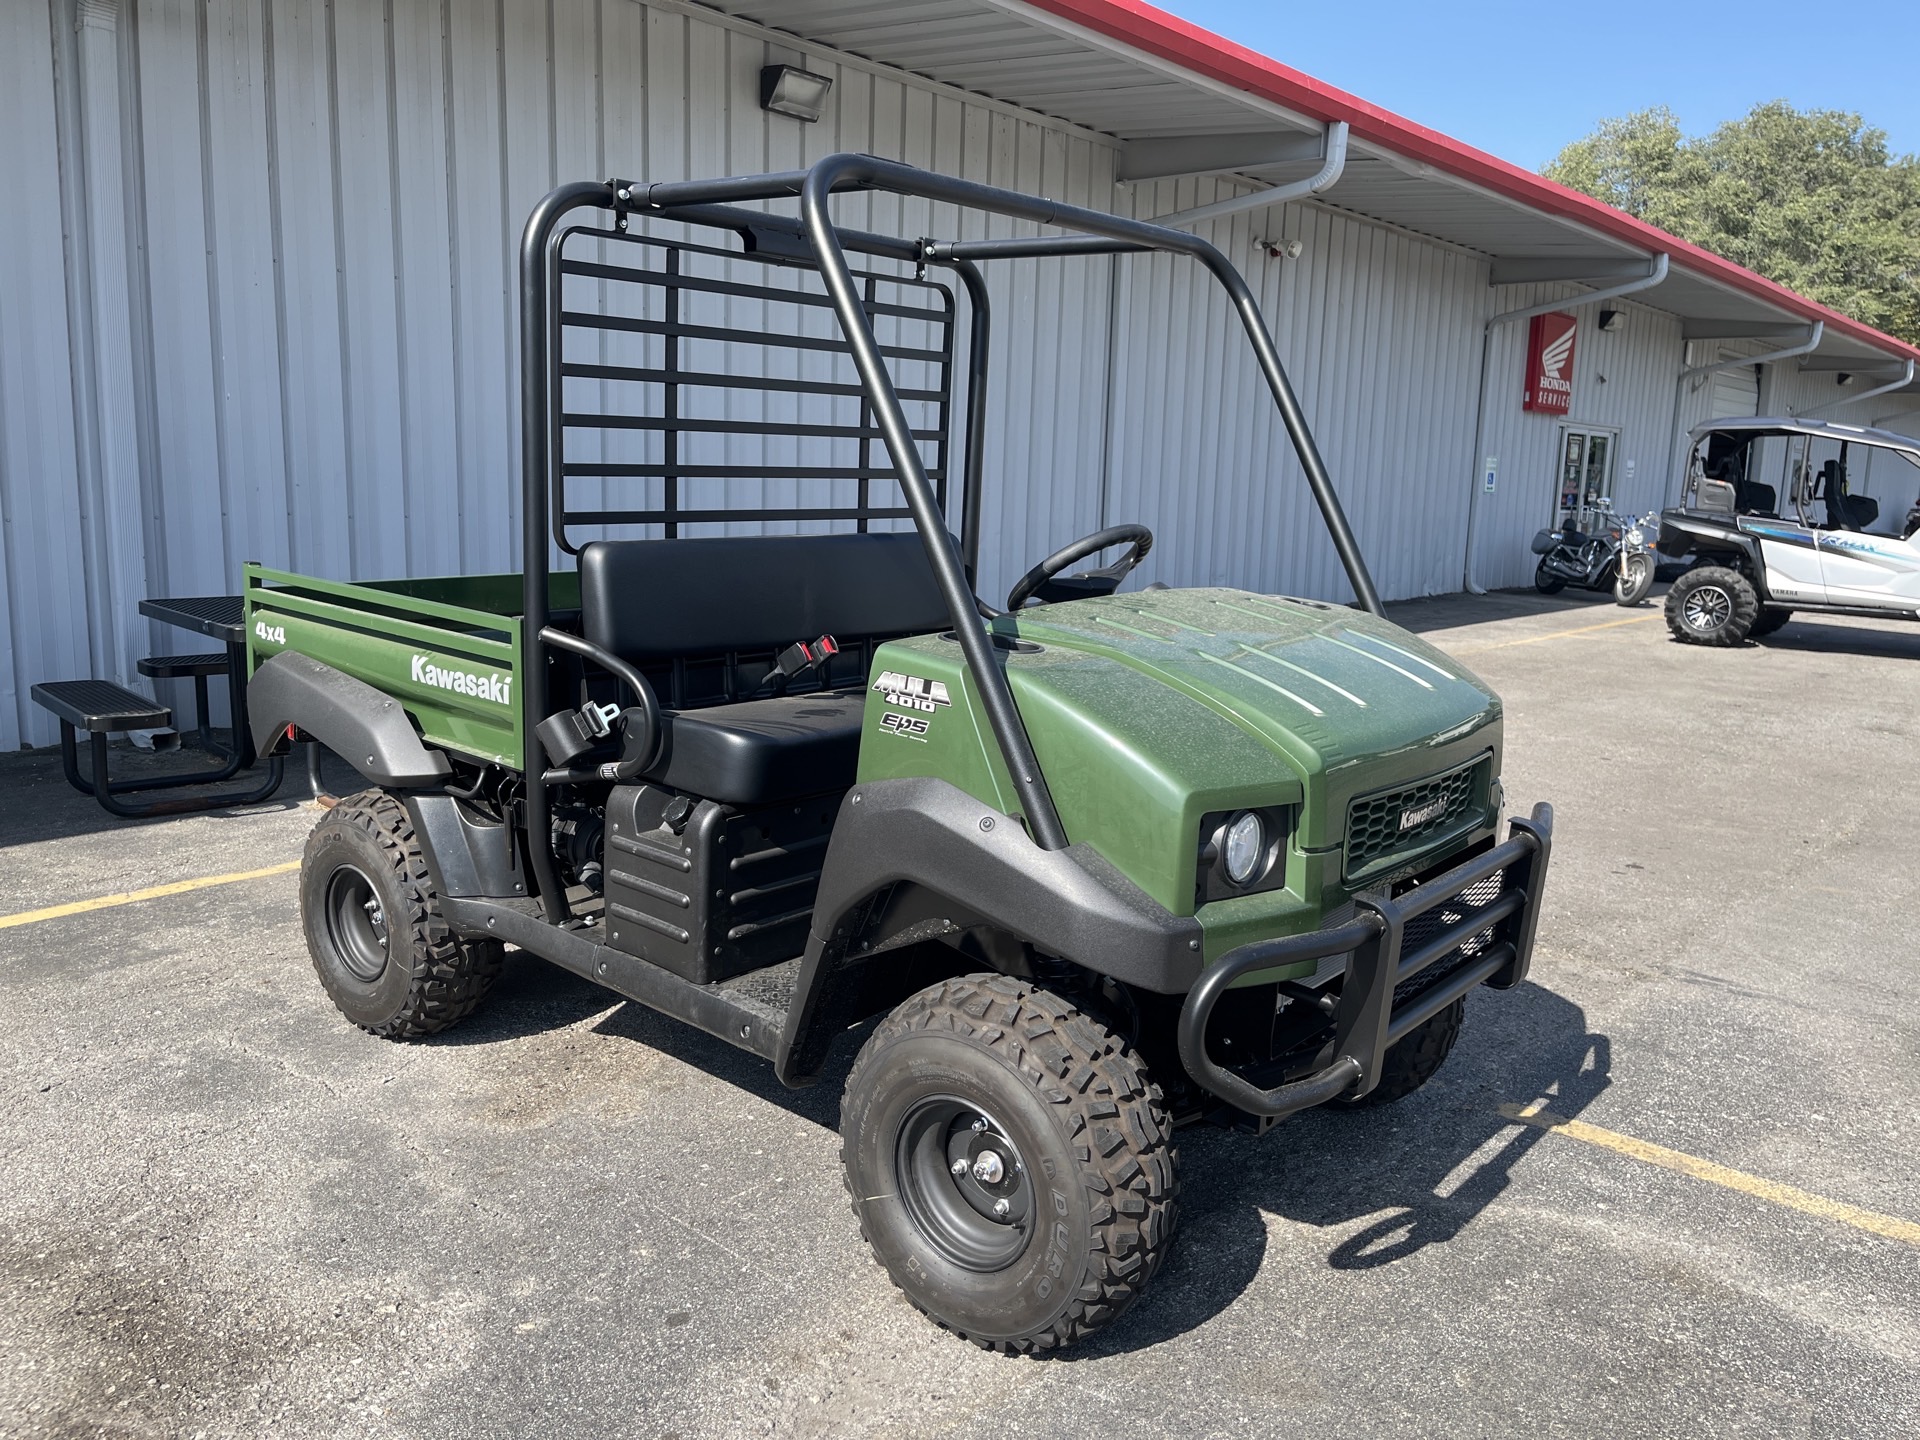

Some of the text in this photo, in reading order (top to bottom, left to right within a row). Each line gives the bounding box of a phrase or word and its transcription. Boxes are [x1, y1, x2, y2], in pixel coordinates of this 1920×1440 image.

[1540, 376, 1571, 392] HONDA
[1538, 391, 1570, 408] SERVICE
[1771, 588, 1798, 597] YAMAHA
[256, 621, 286, 645] 4x4
[411, 654, 512, 705] Kawasaki
[885, 693, 936, 713] 4010
[880, 712, 930, 735] EPS
[1400, 796, 1447, 830] Kawasaki
[1037, 1188, 1070, 1299] DURO
